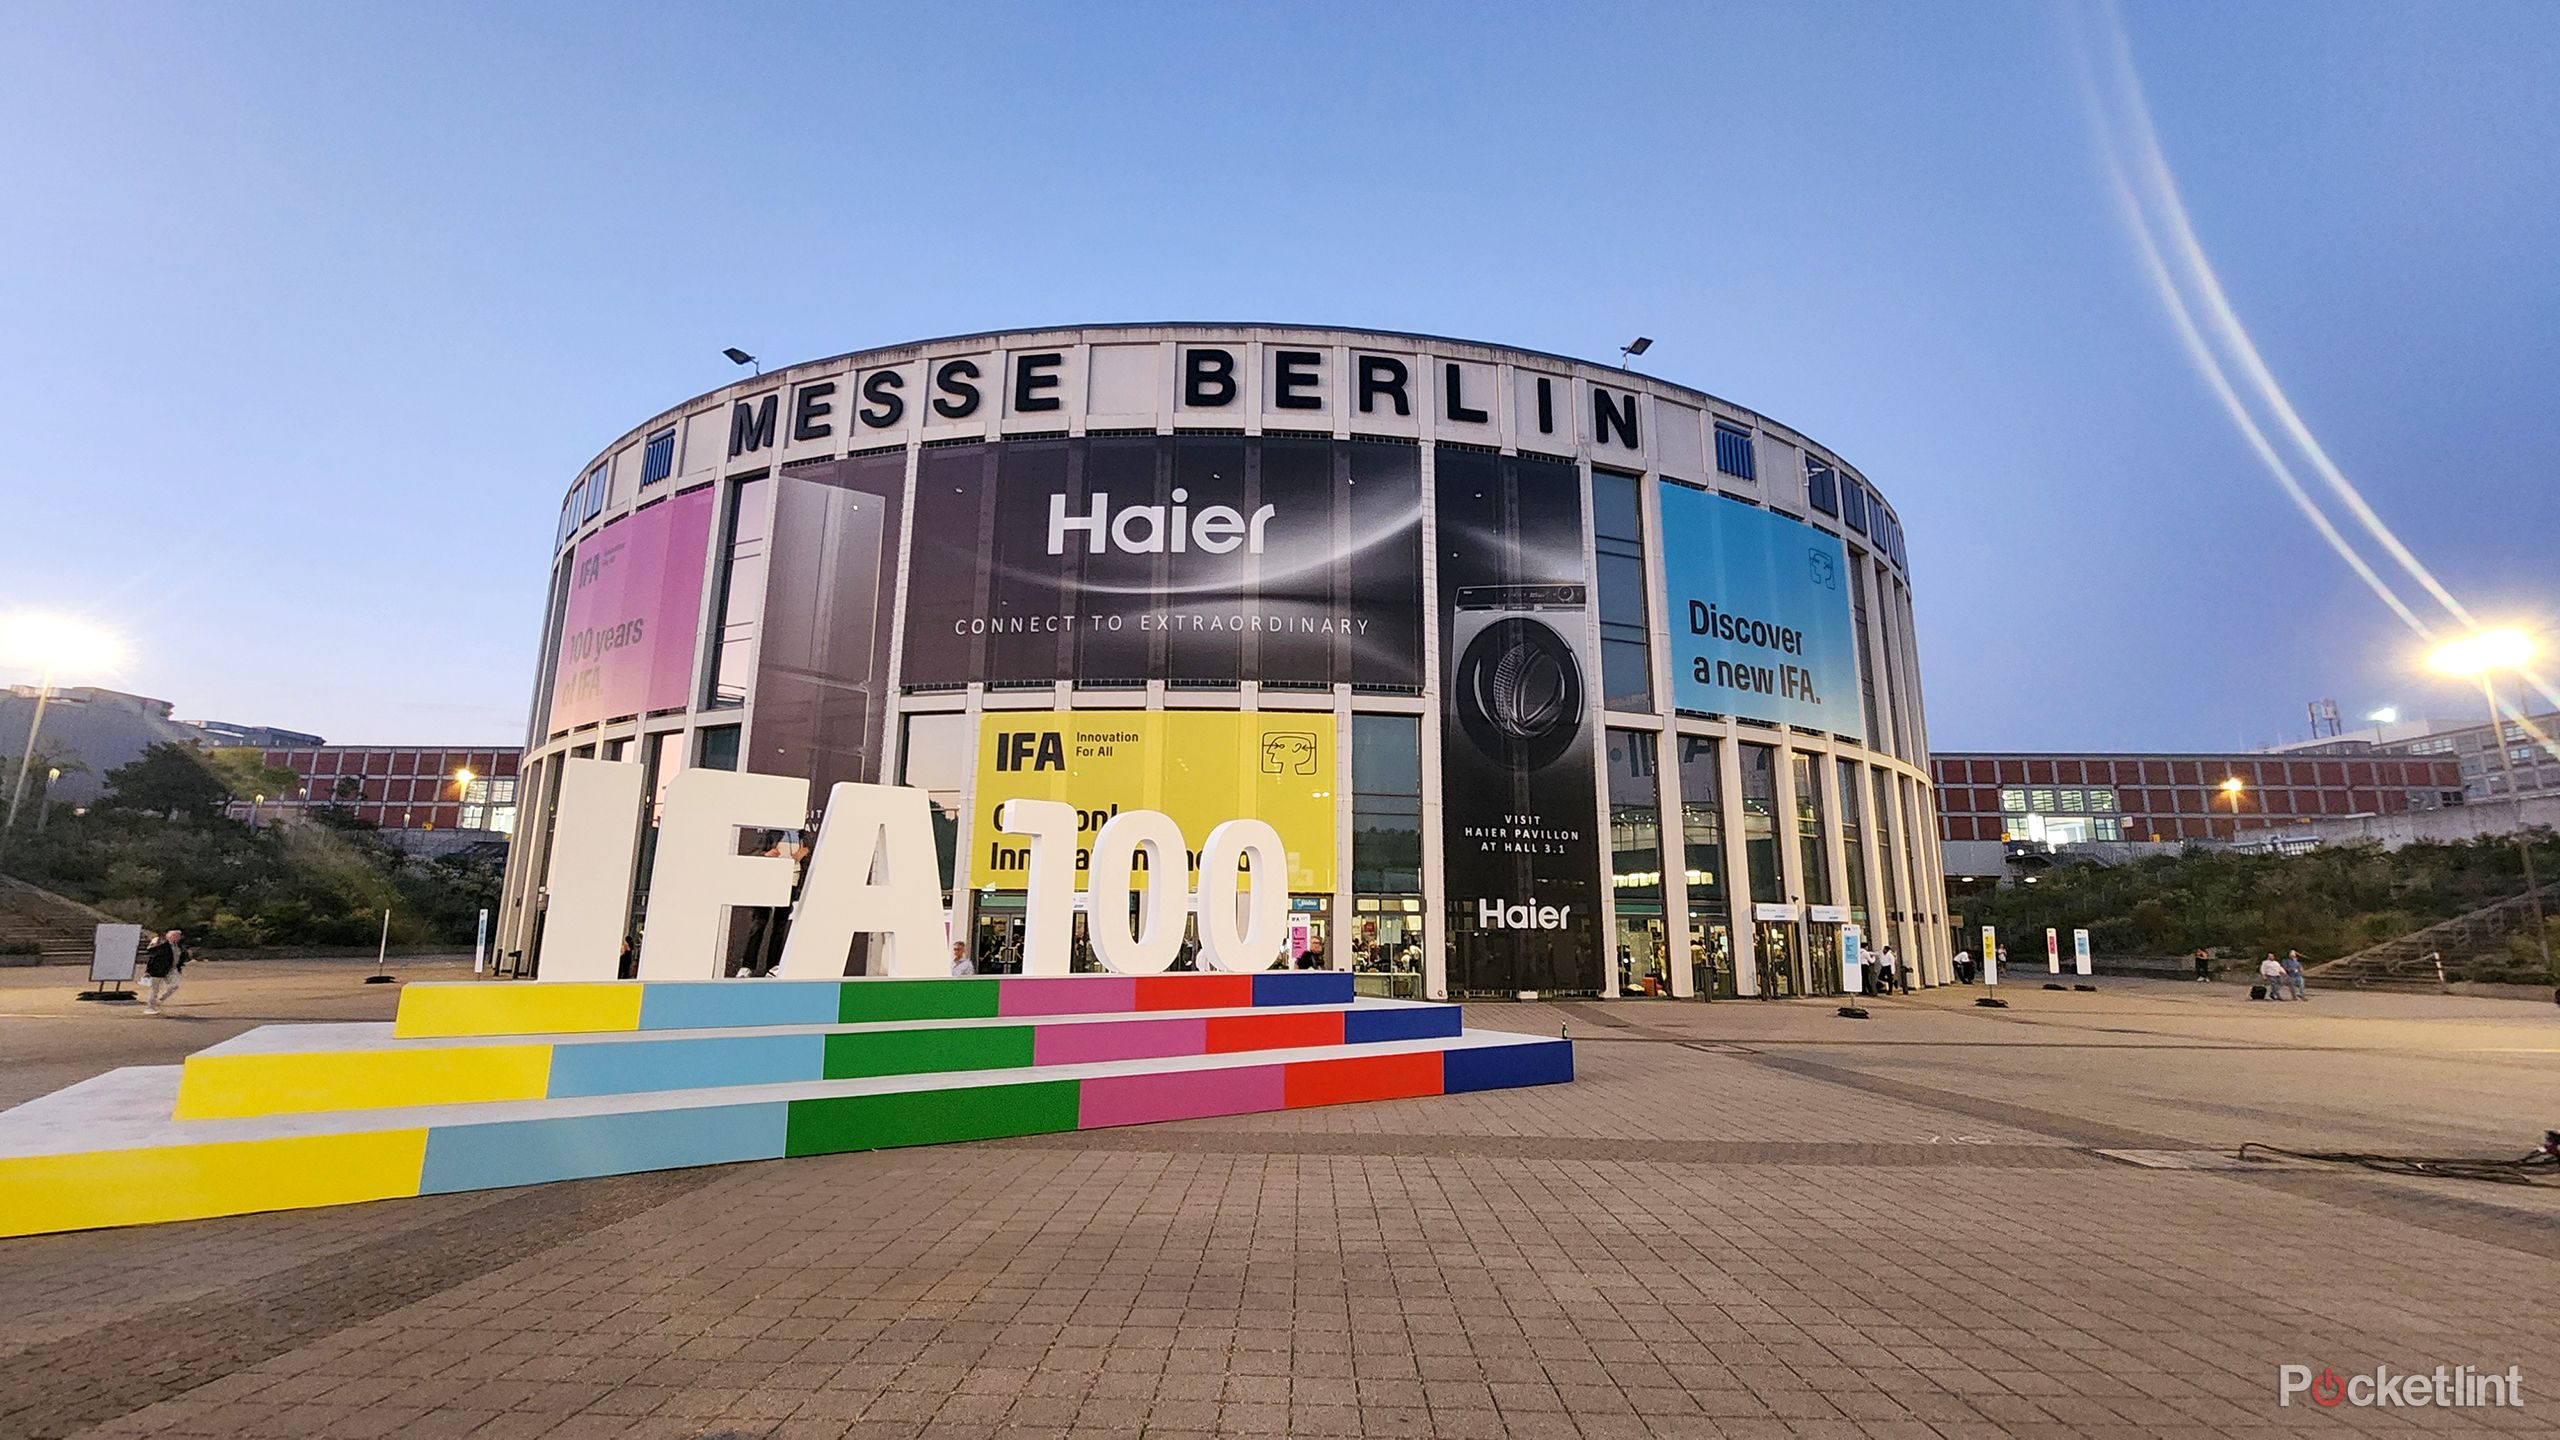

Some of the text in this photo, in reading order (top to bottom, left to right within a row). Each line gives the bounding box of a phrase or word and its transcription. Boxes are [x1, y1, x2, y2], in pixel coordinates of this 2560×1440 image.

[729, 348, 1639, 457] MESSE BERLIN
[1046, 487, 1277, 556] Haier
[578, 553, 601, 589] IFA
[569, 617, 645, 665] 100 years
[954, 615, 1370, 636] CONNECT TO EXTRAORDINARY
[1688, 599, 1803, 656] Discover
[1693, 656, 1822, 705] a new IFA.
[995, 731, 1067, 772] IFA
[1075, 745, 1114, 757] For All
[1076, 731, 1139, 743] Innovation
[1464, 827, 1579, 840] HAIER PAVILLON
[1504, 814, 1541, 825] VISIT
[1481, 842, 1566, 854] AT HALL 3.1
[538, 757, 1289, 981] IFA 100
[1478, 897, 1571, 930] Haier
